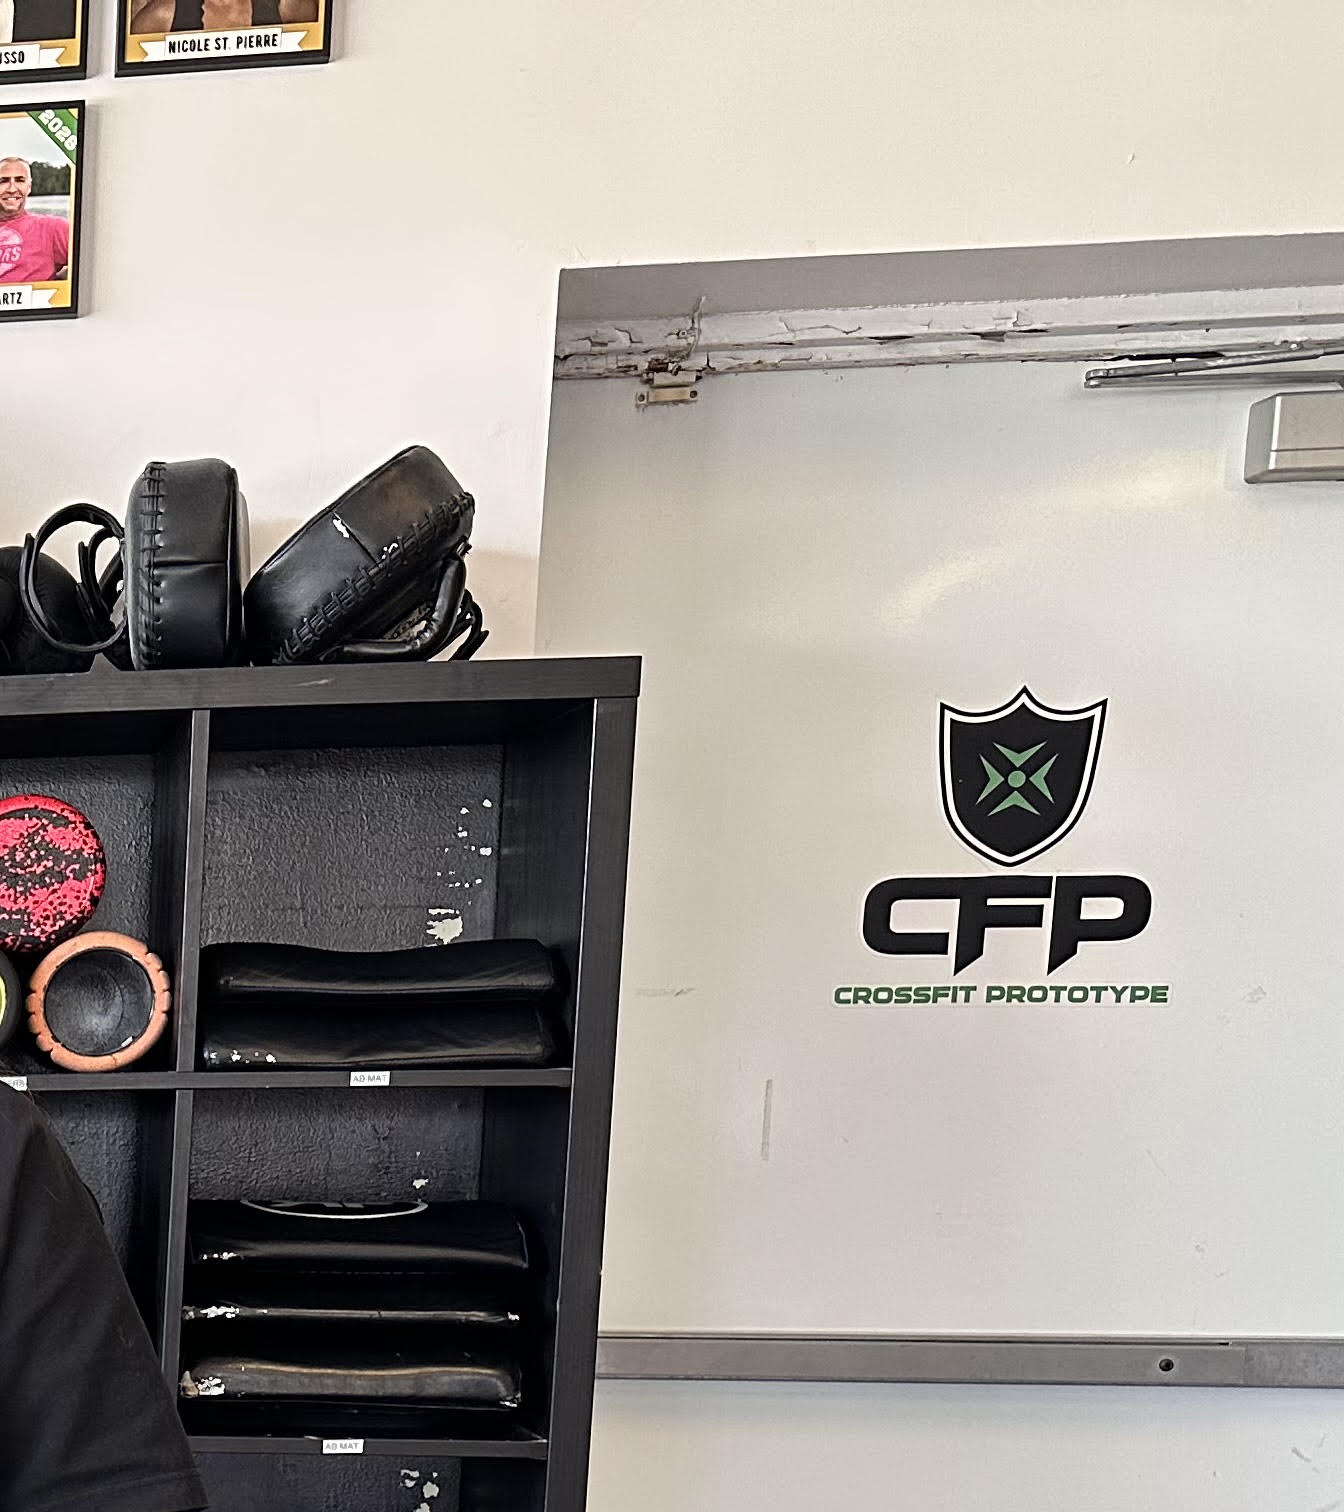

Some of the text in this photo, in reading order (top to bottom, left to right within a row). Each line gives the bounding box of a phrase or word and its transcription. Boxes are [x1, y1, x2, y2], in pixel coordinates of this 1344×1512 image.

[167, 37, 212, 55] NICOLE
[235, 32, 280, 51] PIERRE
[862, 874, 1153, 978] CFP
[833, 984, 1170, 1005] CROSSFIT PROTOTYPE
